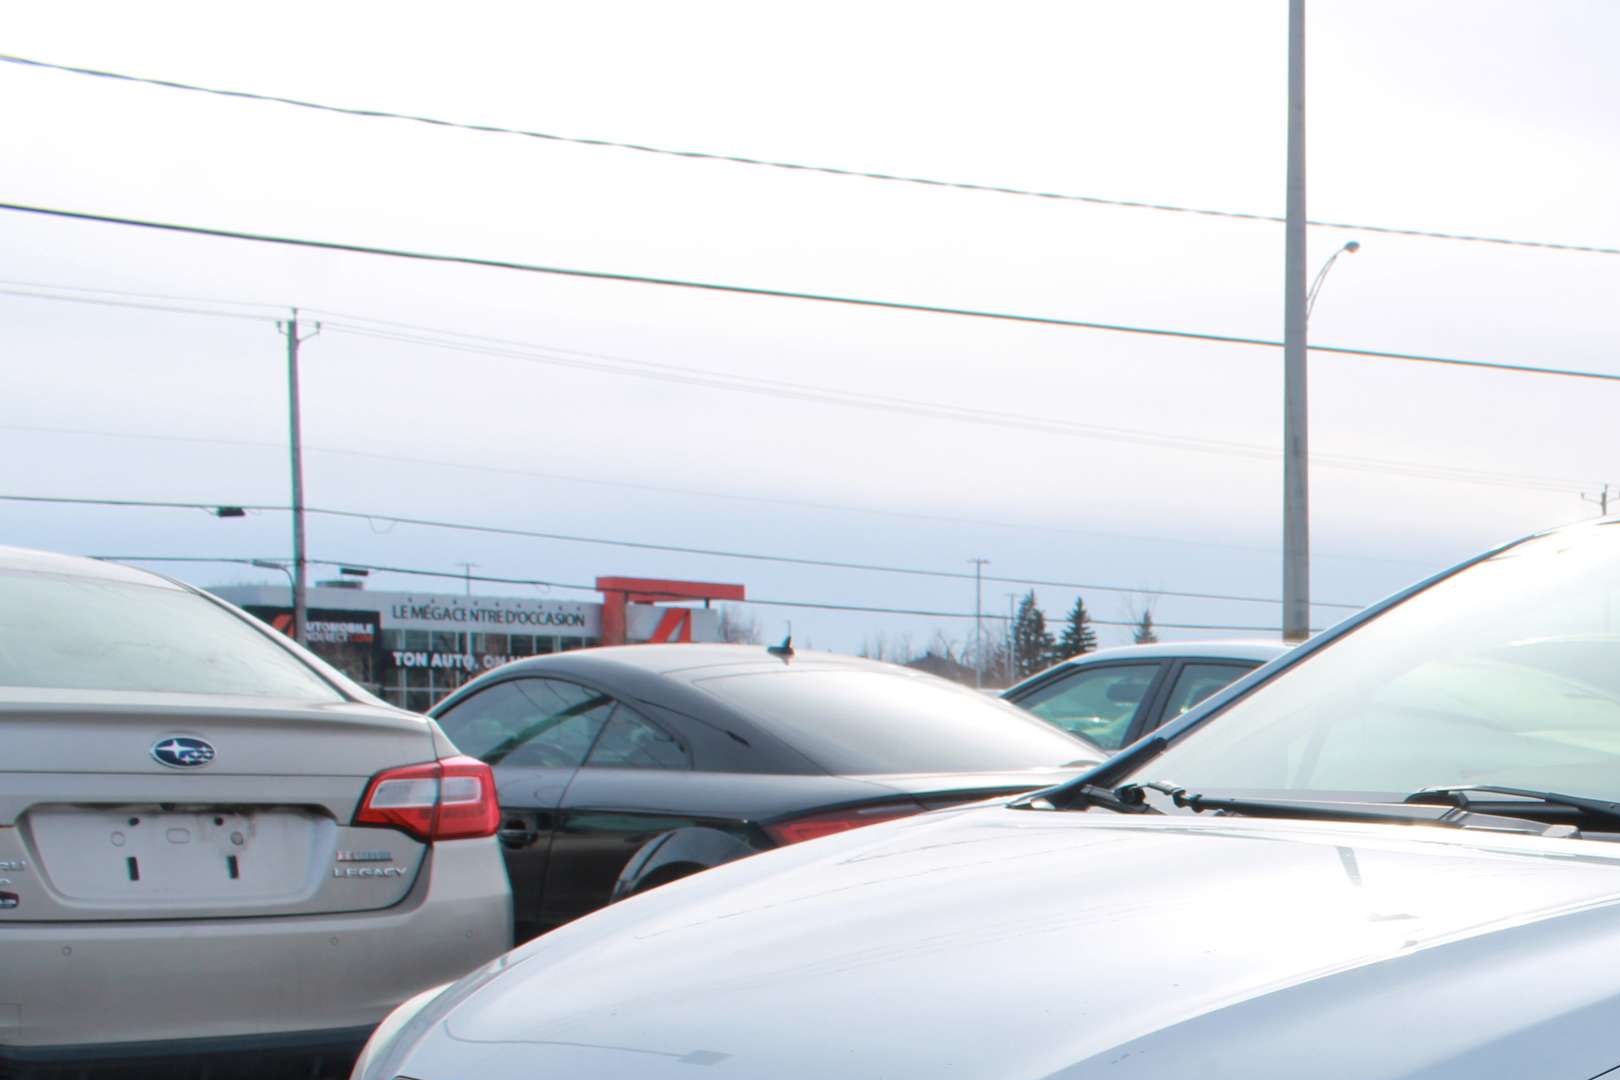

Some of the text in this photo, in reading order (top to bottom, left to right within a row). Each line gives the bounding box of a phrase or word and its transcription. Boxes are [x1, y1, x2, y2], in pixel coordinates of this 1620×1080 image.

[393, 604, 408, 619] LE
[505, 608, 585, 627] D'OCCASION
[393, 652, 428, 667] TON
[333, 866, 408, 878] LEGACY
